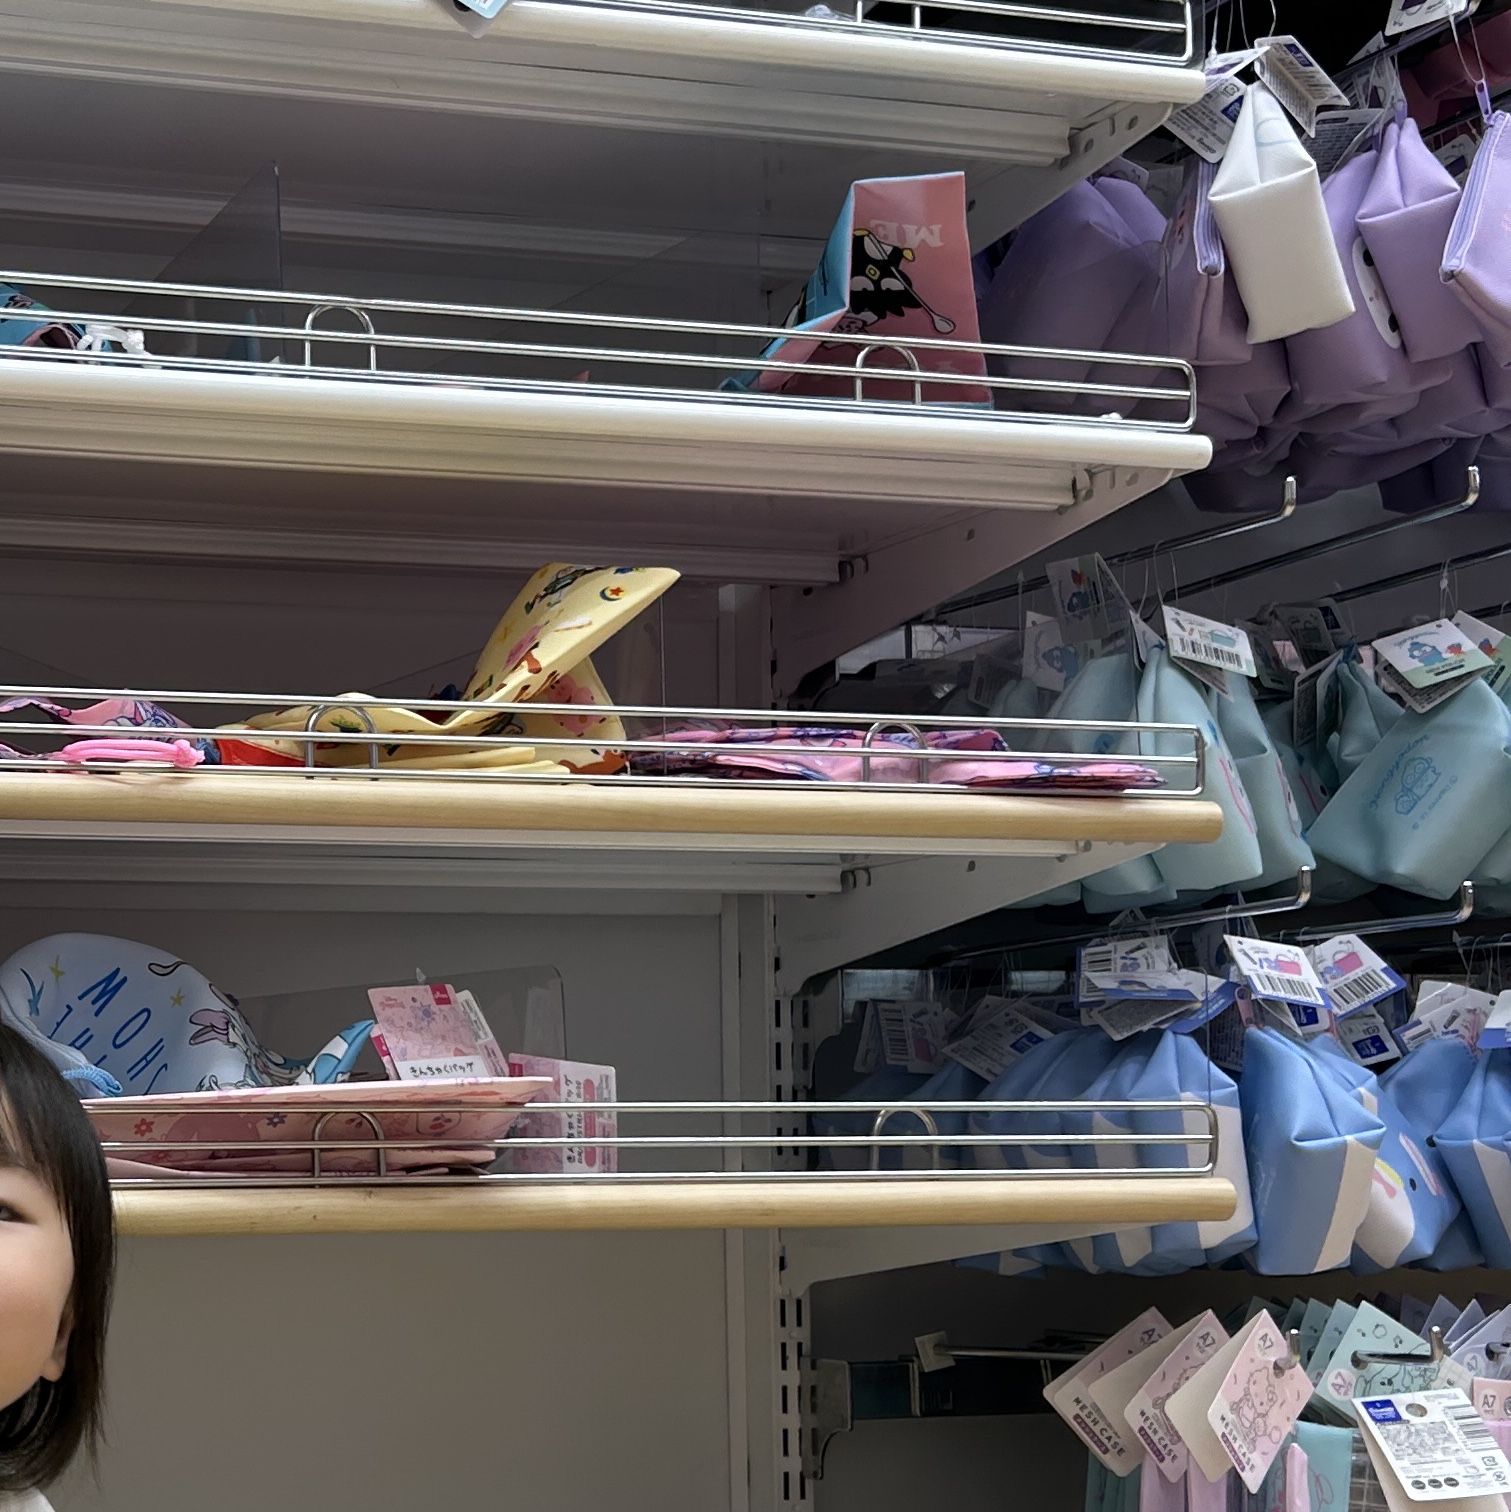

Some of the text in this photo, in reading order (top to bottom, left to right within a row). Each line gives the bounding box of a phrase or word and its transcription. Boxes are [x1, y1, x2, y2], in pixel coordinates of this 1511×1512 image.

[1199, 1331, 1217, 1349] A7
[1258, 1332, 1275, 1350] A7
[1481, 1393, 1497, 1409] A7
[1072, 1396, 1100, 1429] MESH
[1098, 1426, 1127, 1458] CASE
[1138, 1409, 1179, 1464] MESH CASE
[1219, 1414, 1256, 1474] MESH CASE
